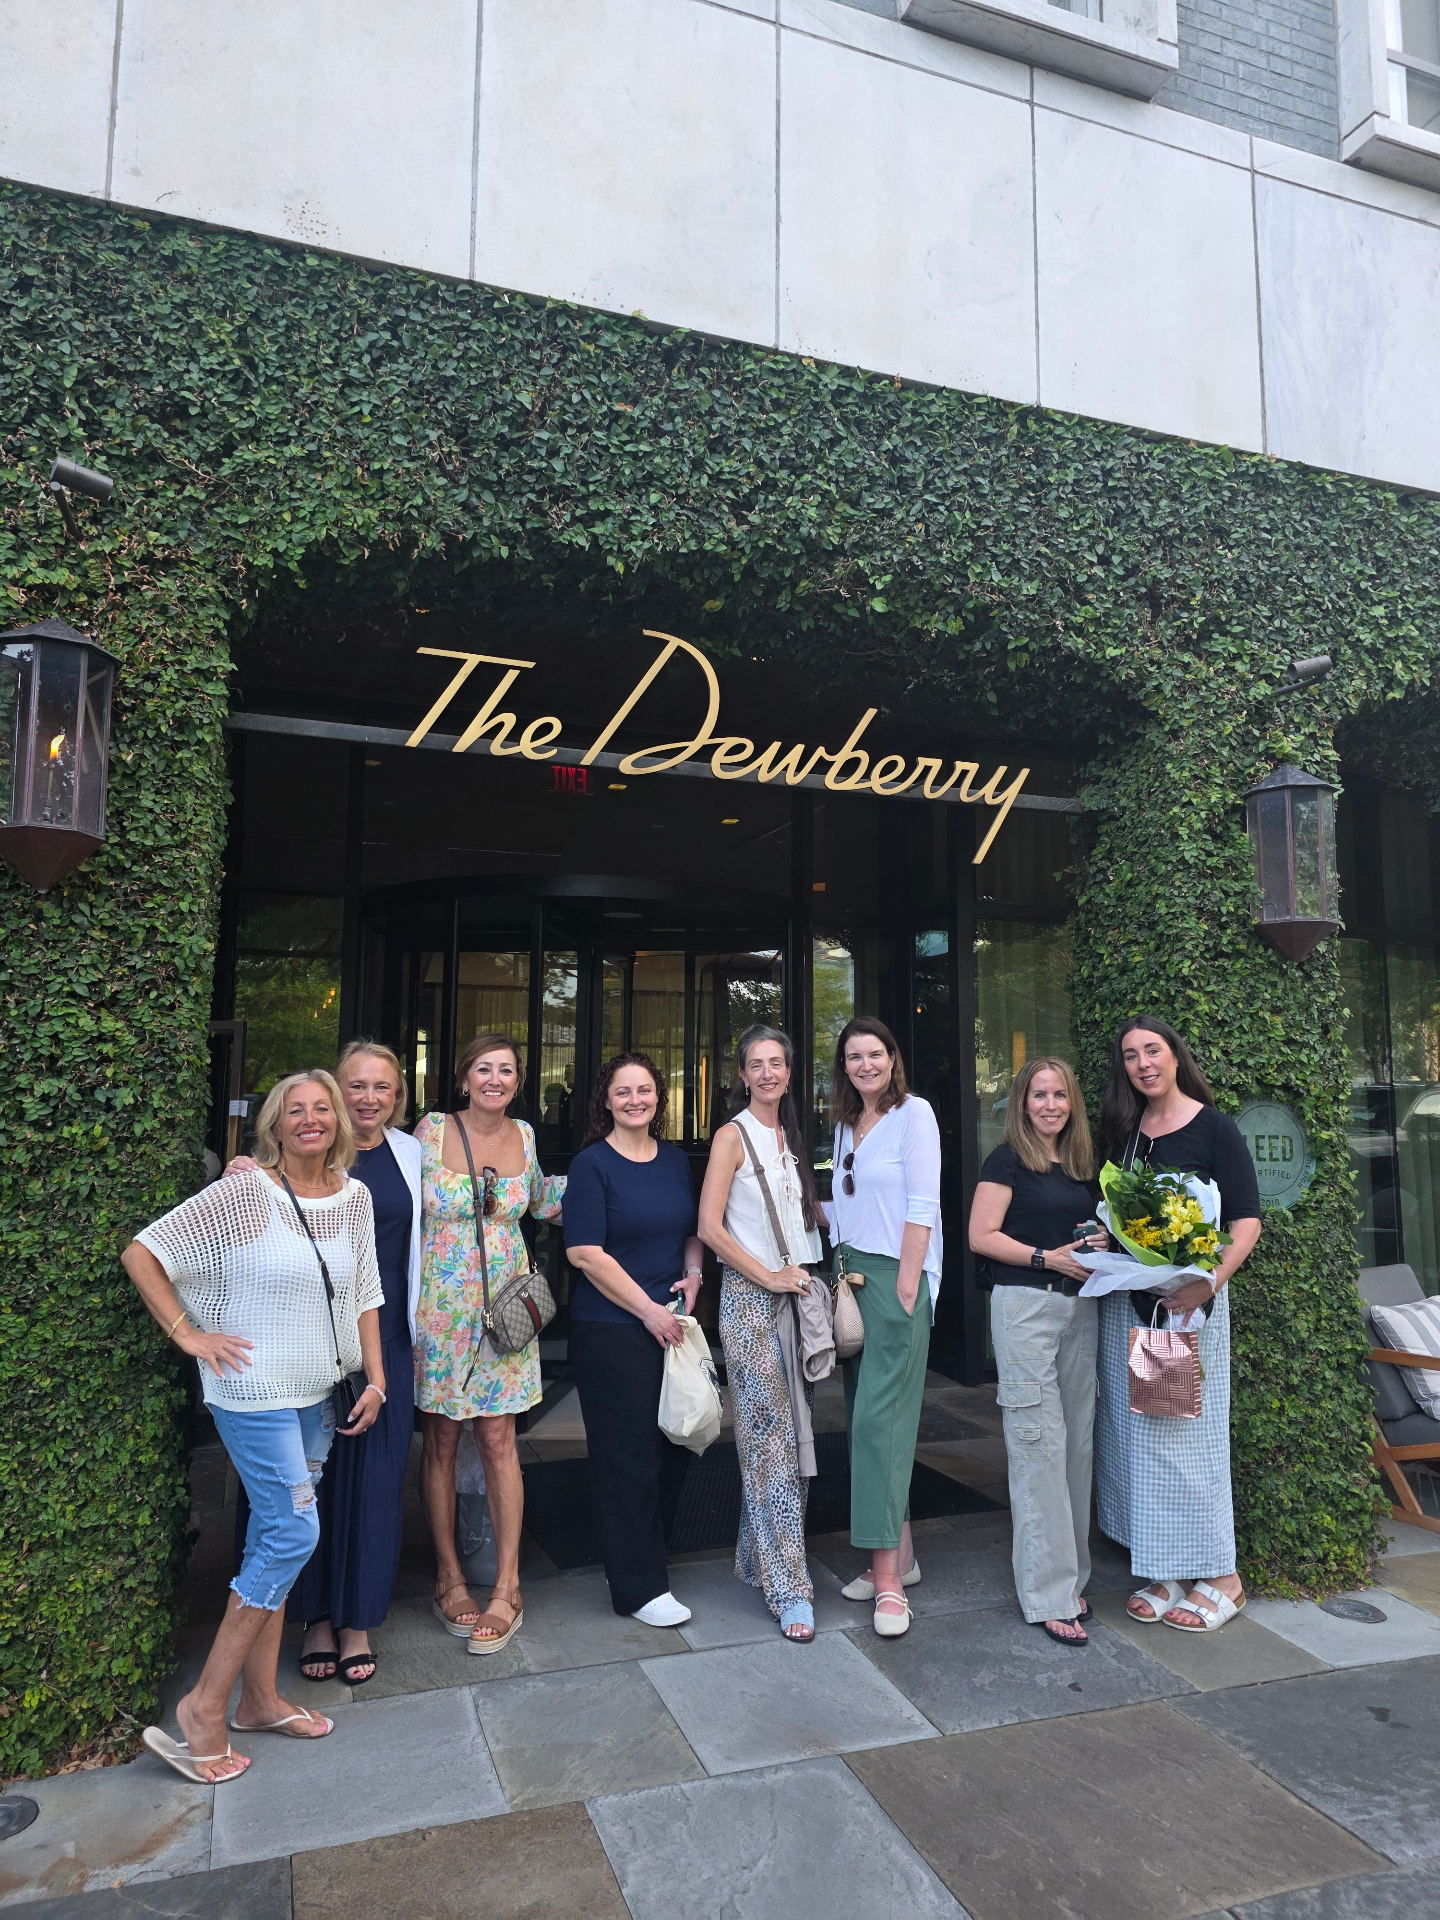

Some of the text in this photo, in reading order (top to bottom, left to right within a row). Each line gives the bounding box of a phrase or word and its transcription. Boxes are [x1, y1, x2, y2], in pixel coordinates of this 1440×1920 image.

[404, 628, 1031, 865] The Dewberry
[1242, 1134, 1294, 1163] EED
[1257, 1169, 1292, 1180] RTIFIED
